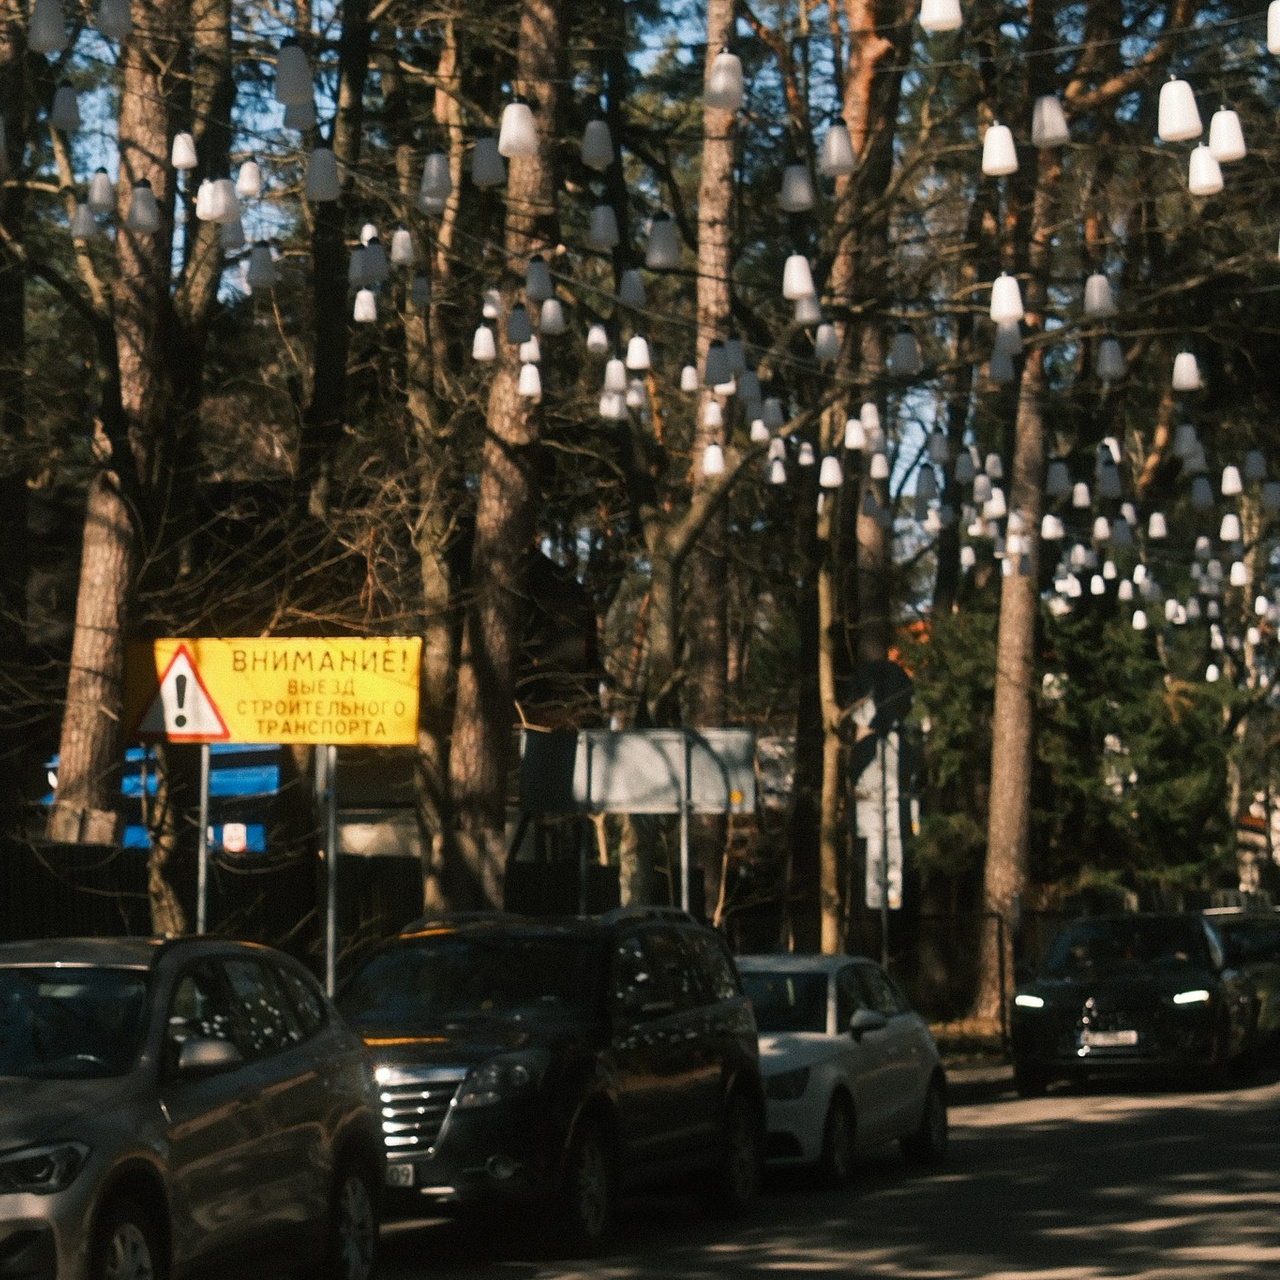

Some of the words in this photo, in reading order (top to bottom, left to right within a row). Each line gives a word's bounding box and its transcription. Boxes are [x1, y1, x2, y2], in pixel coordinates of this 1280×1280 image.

[232, 649, 408, 673] ВНИМАНИЕ!
[287, 679, 356, 696] ВЫЕЗД
[236, 700, 406, 717] СТРОИТЕЛЬНОГО
[257, 719, 387, 736] ТРАНСПОРТА
